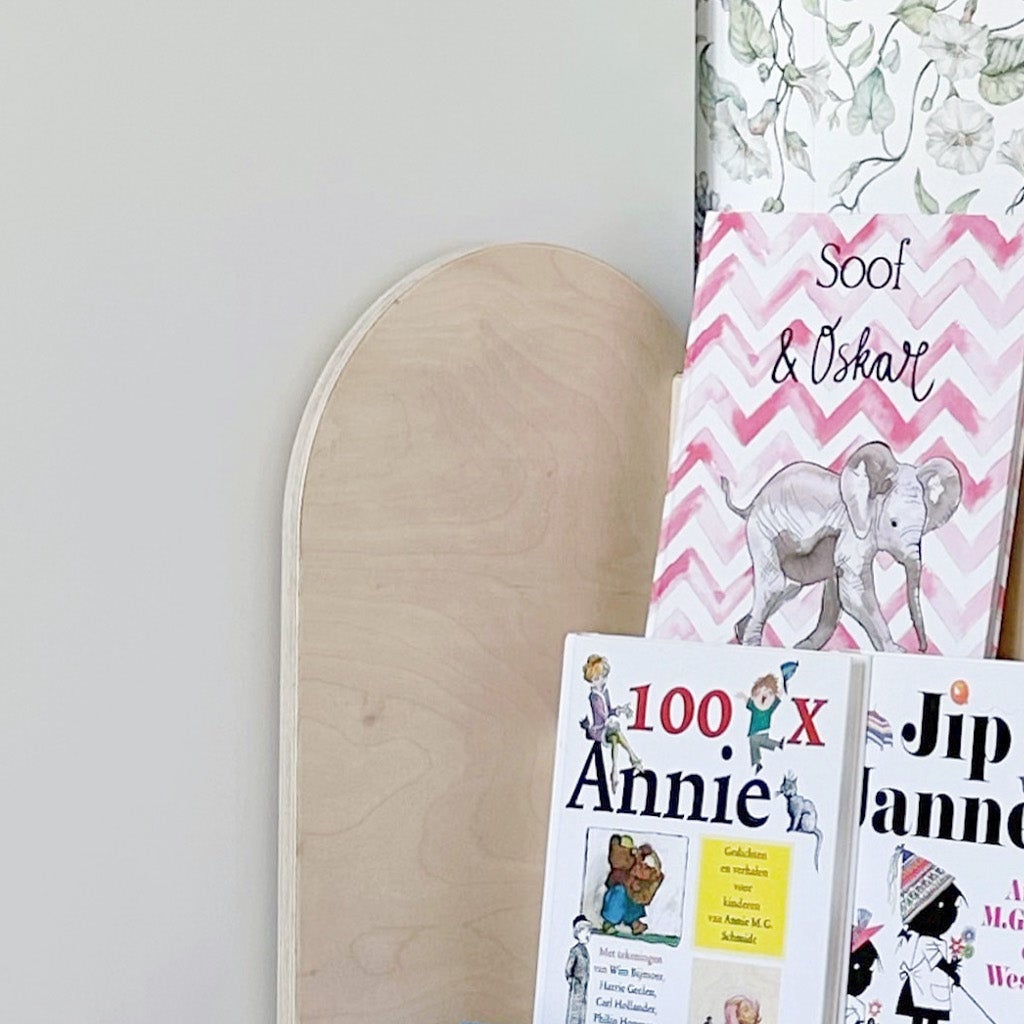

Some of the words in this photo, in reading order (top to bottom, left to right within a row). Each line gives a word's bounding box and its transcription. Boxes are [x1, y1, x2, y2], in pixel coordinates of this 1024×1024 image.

[816, 238, 910, 290] Soof
[771, 328, 799, 384] &
[811, 317, 935, 402] Oskar
[627, 683, 733, 739] 100
[900, 690, 1012, 783] Jip
